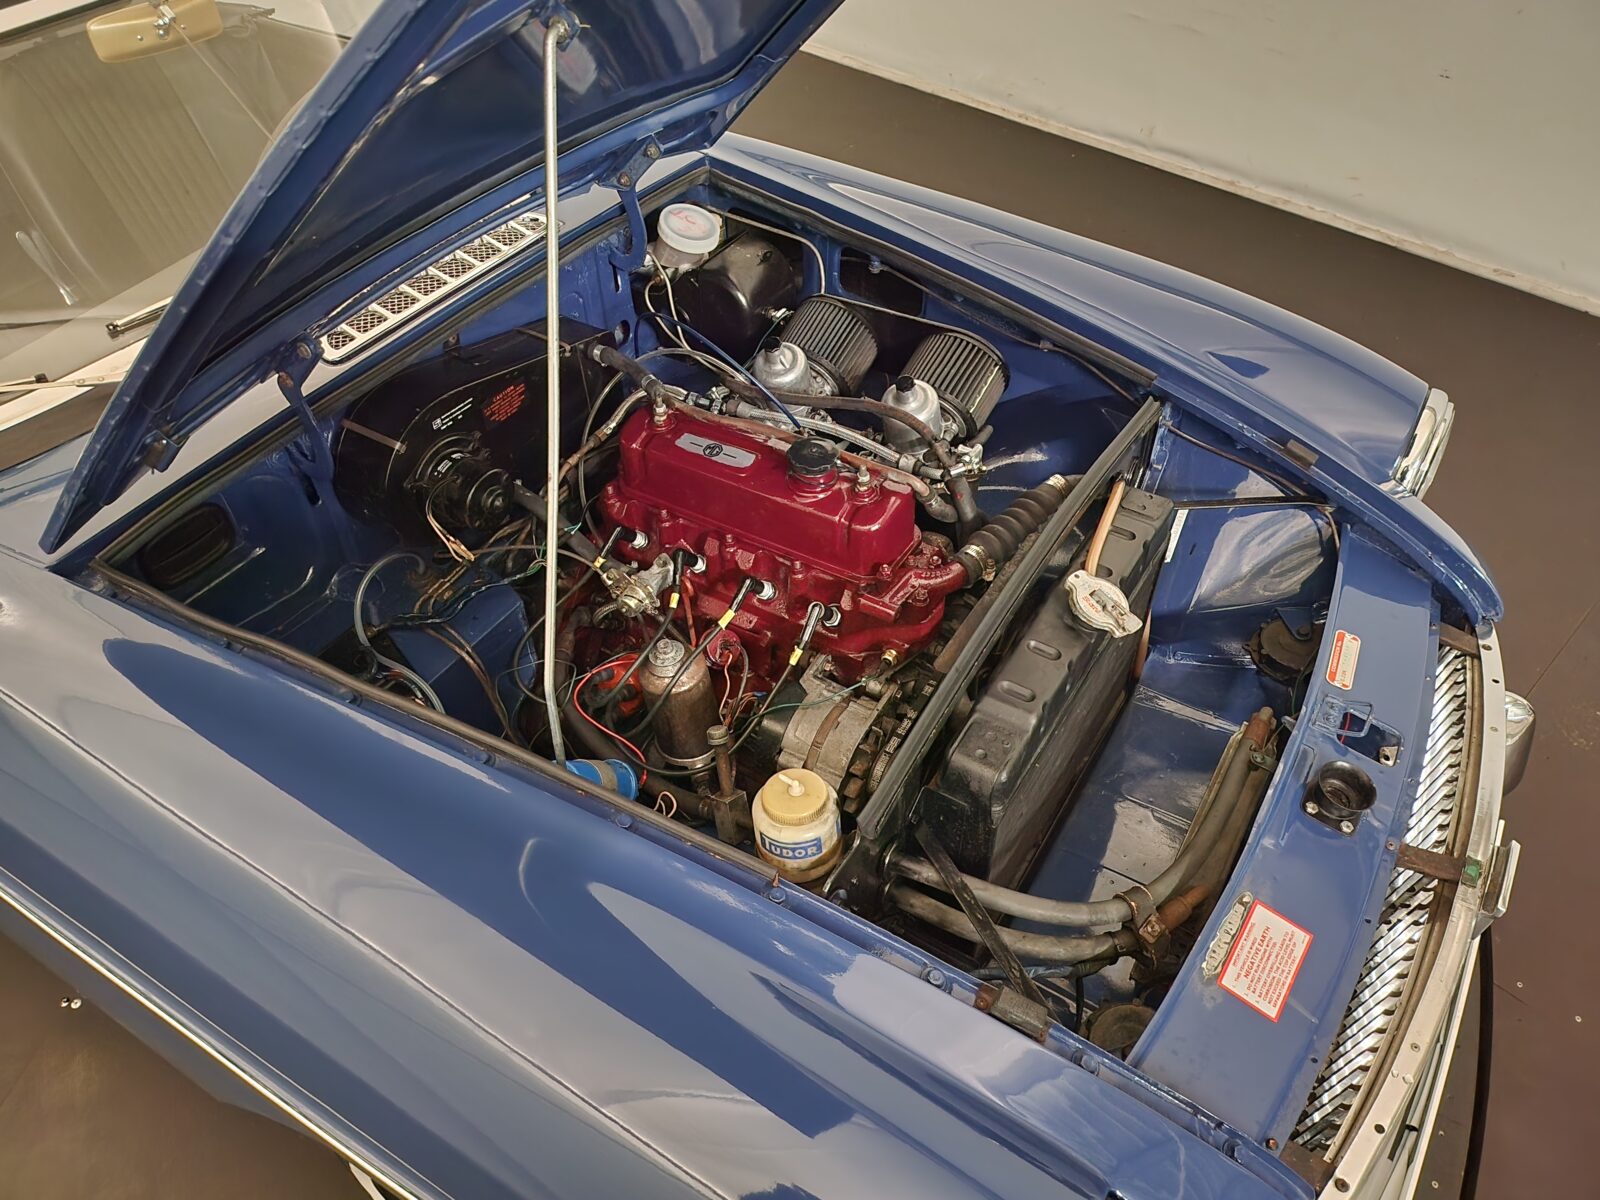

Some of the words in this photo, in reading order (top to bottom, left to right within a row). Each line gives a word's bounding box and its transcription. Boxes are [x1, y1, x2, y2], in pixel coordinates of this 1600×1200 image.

[704, 444, 722, 456] MG
[762, 835, 818, 857] TUDOR
[1239, 955, 1249, 972] VEHICLE
[1249, 936, 1258, 951] WIRED
[1243, 945, 1262, 980] NEGATIVE
[1257, 925, 1271, 948] EARTH
[1282, 942, 1291, 956] LEVEL
[1288, 930, 1296, 943] MUST
[1246, 983, 1252, 991] DO
[1249, 973, 1257, 984] NOT
[1258, 948, 1268, 964] ENGINE
[1265, 936, 1273, 948] WITH
[1257, 978, 1269, 998] BATTERY
[1266, 951, 1281, 979] OVERFILLING
[1278, 937, 1287, 952] LEADS
[1272, 977, 1282, 995] EXCEED
[1287, 948, 1295, 960] EDGE
[1292, 941, 1297, 949] OF
[1251, 974, 1263, 994] BATTERY
